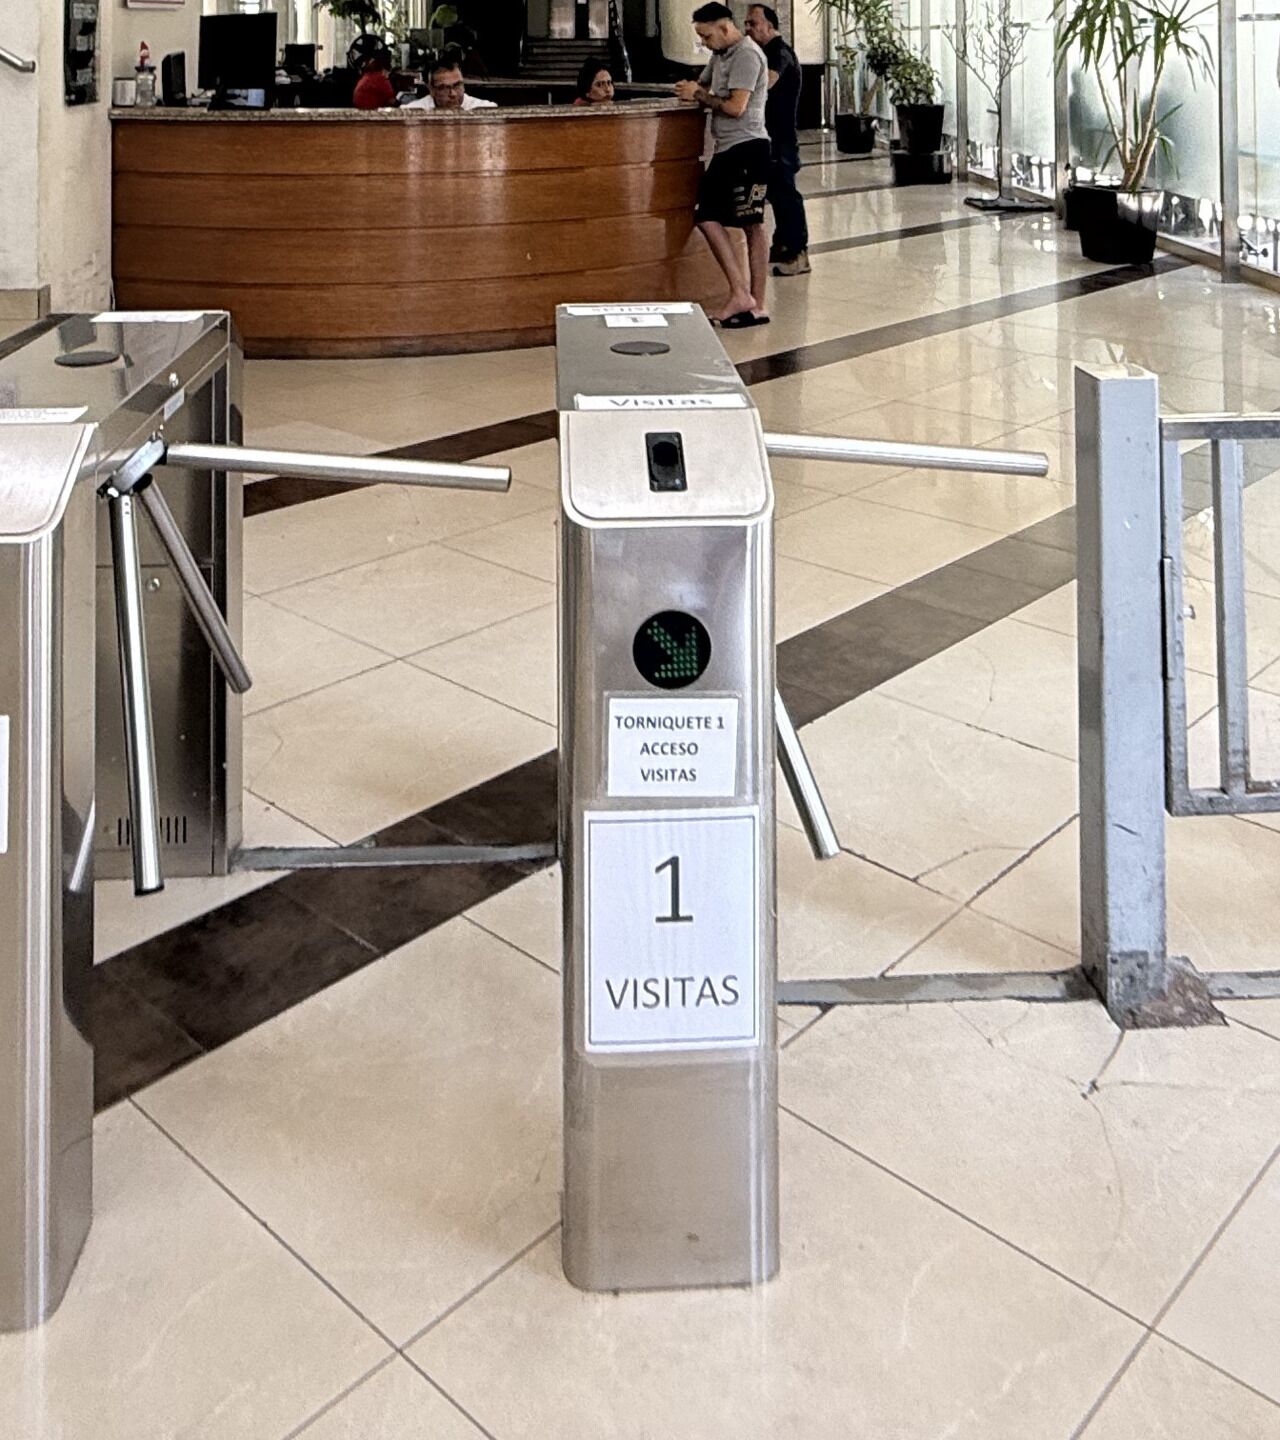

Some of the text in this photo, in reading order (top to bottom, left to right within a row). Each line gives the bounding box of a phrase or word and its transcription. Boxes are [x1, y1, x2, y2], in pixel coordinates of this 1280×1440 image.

[614, 715, 725, 731] TORNIQUETE 1
[640, 742, 699, 756] ACCESO
[640, 767, 697, 782] VISITAS
[654, 855, 694, 924] 1
[605, 974, 740, 1010] VISITAS
